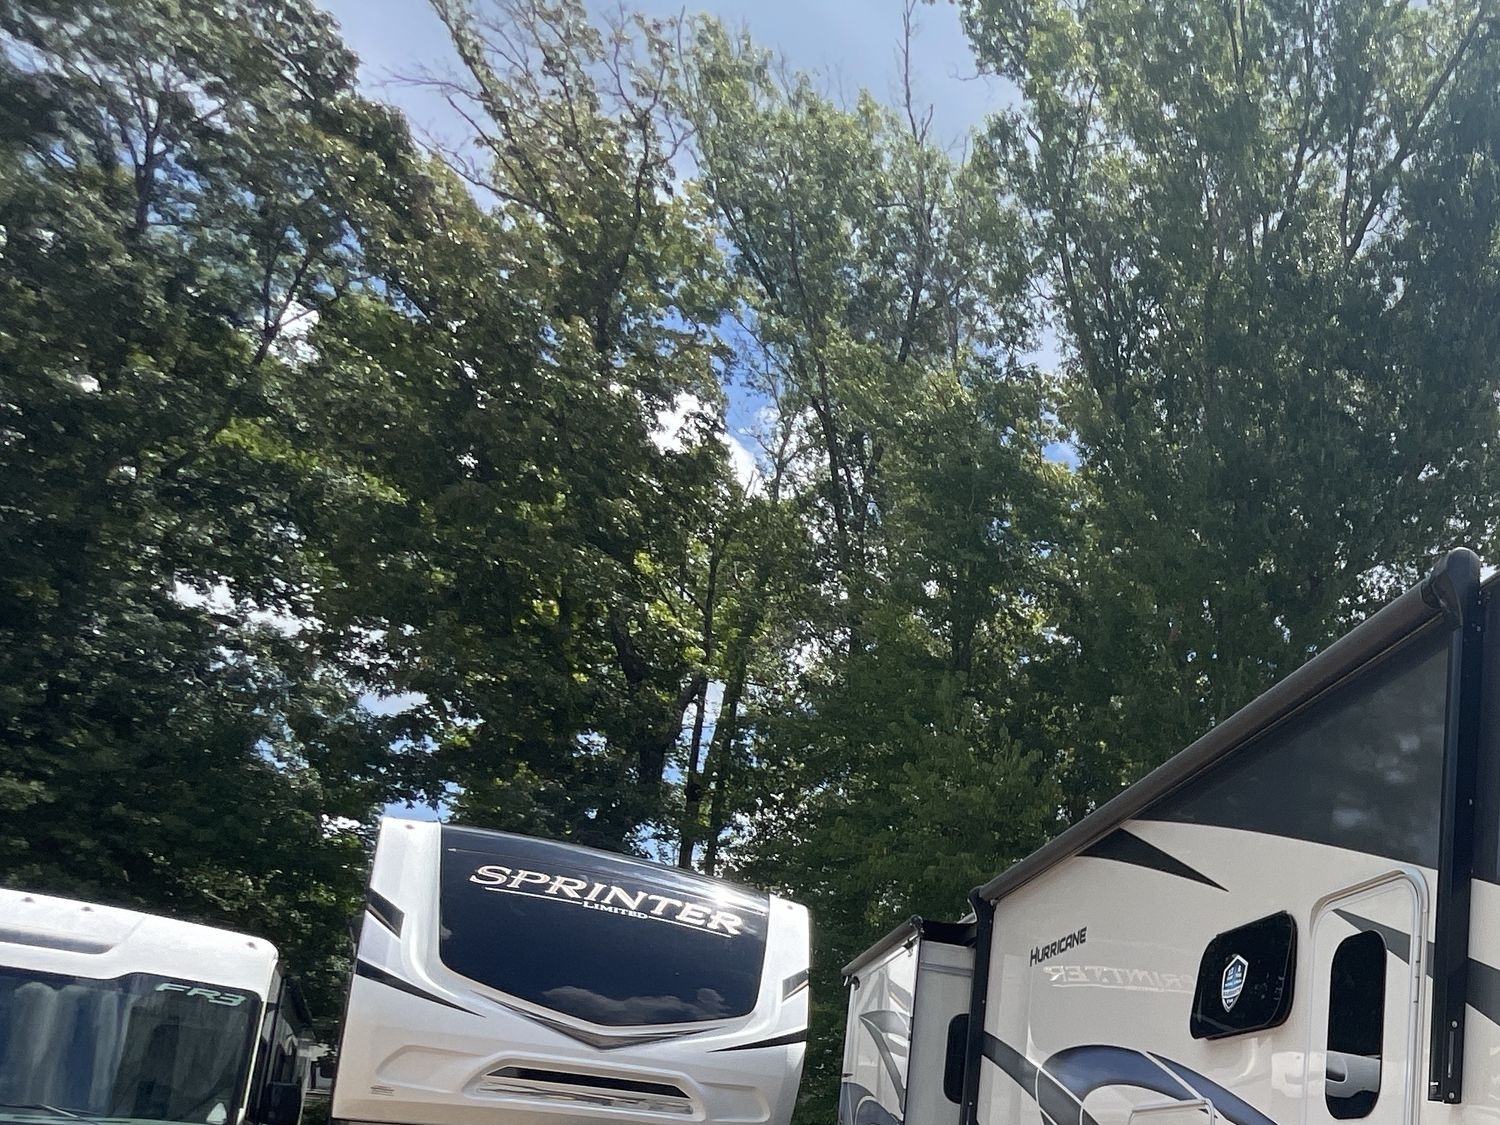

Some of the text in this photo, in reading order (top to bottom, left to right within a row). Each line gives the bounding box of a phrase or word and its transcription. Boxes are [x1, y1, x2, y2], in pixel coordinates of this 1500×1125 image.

[468, 864, 744, 936] SPRINTER
[583, 900, 649, 919] LIMITED
[1029, 926, 1087, 967] HURRICANE
[155, 983, 246, 1006] FR3
